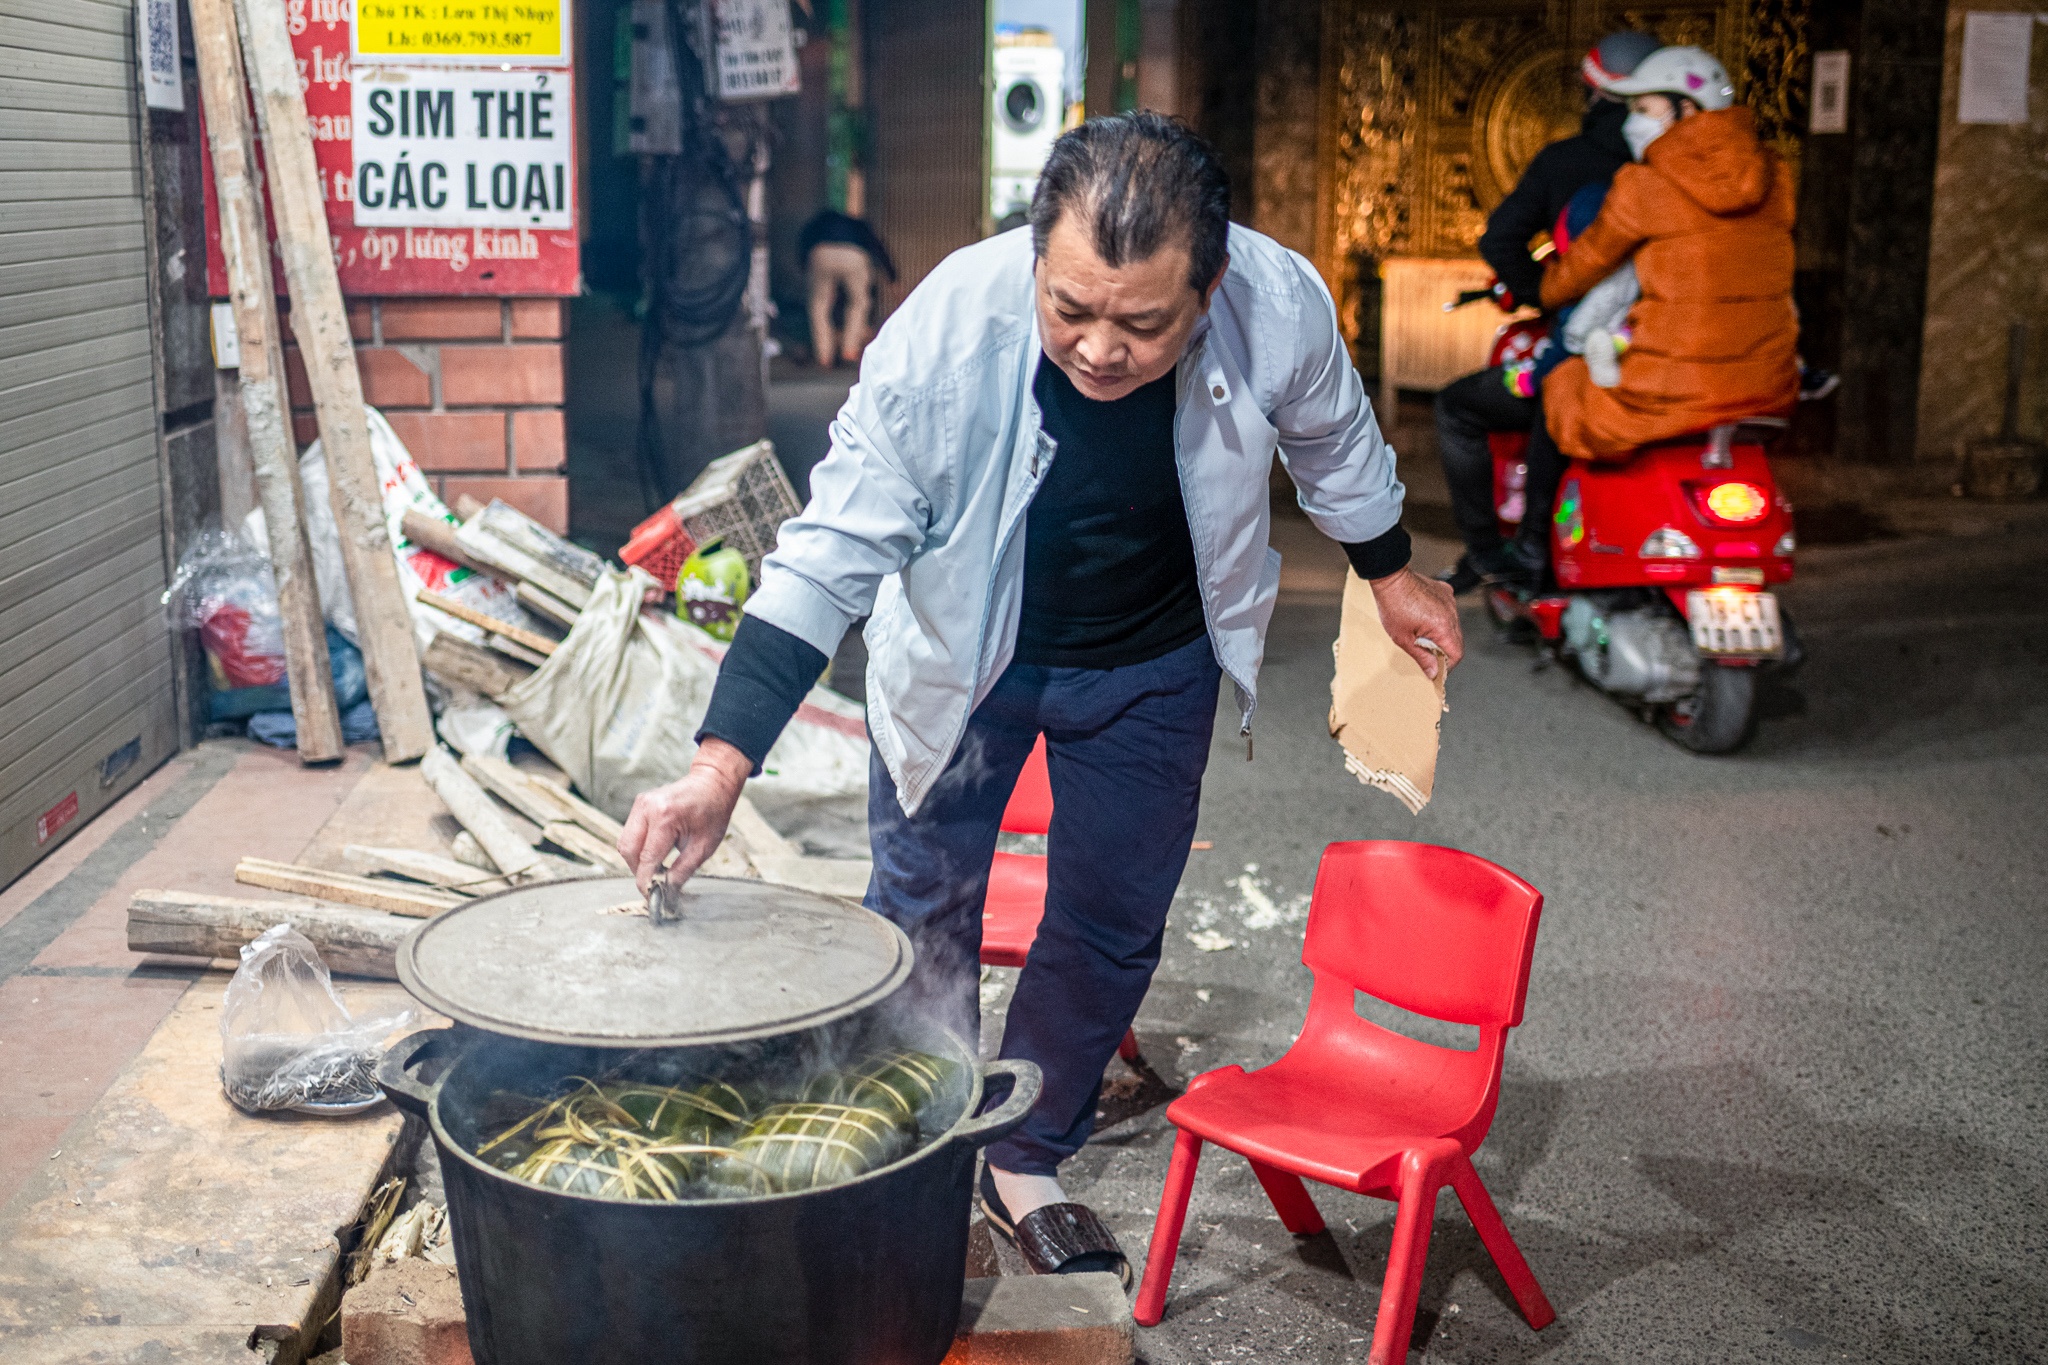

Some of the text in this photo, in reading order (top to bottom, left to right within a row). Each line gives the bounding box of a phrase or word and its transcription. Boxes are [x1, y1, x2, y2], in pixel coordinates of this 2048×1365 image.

[402, 5, 427, 20] TK
[368, 75, 554, 139] SIM THẺ
[358, 151, 448, 209] CÁC
[466, 162, 564, 223] LOẠI
[404, 228, 470, 272] lưng
